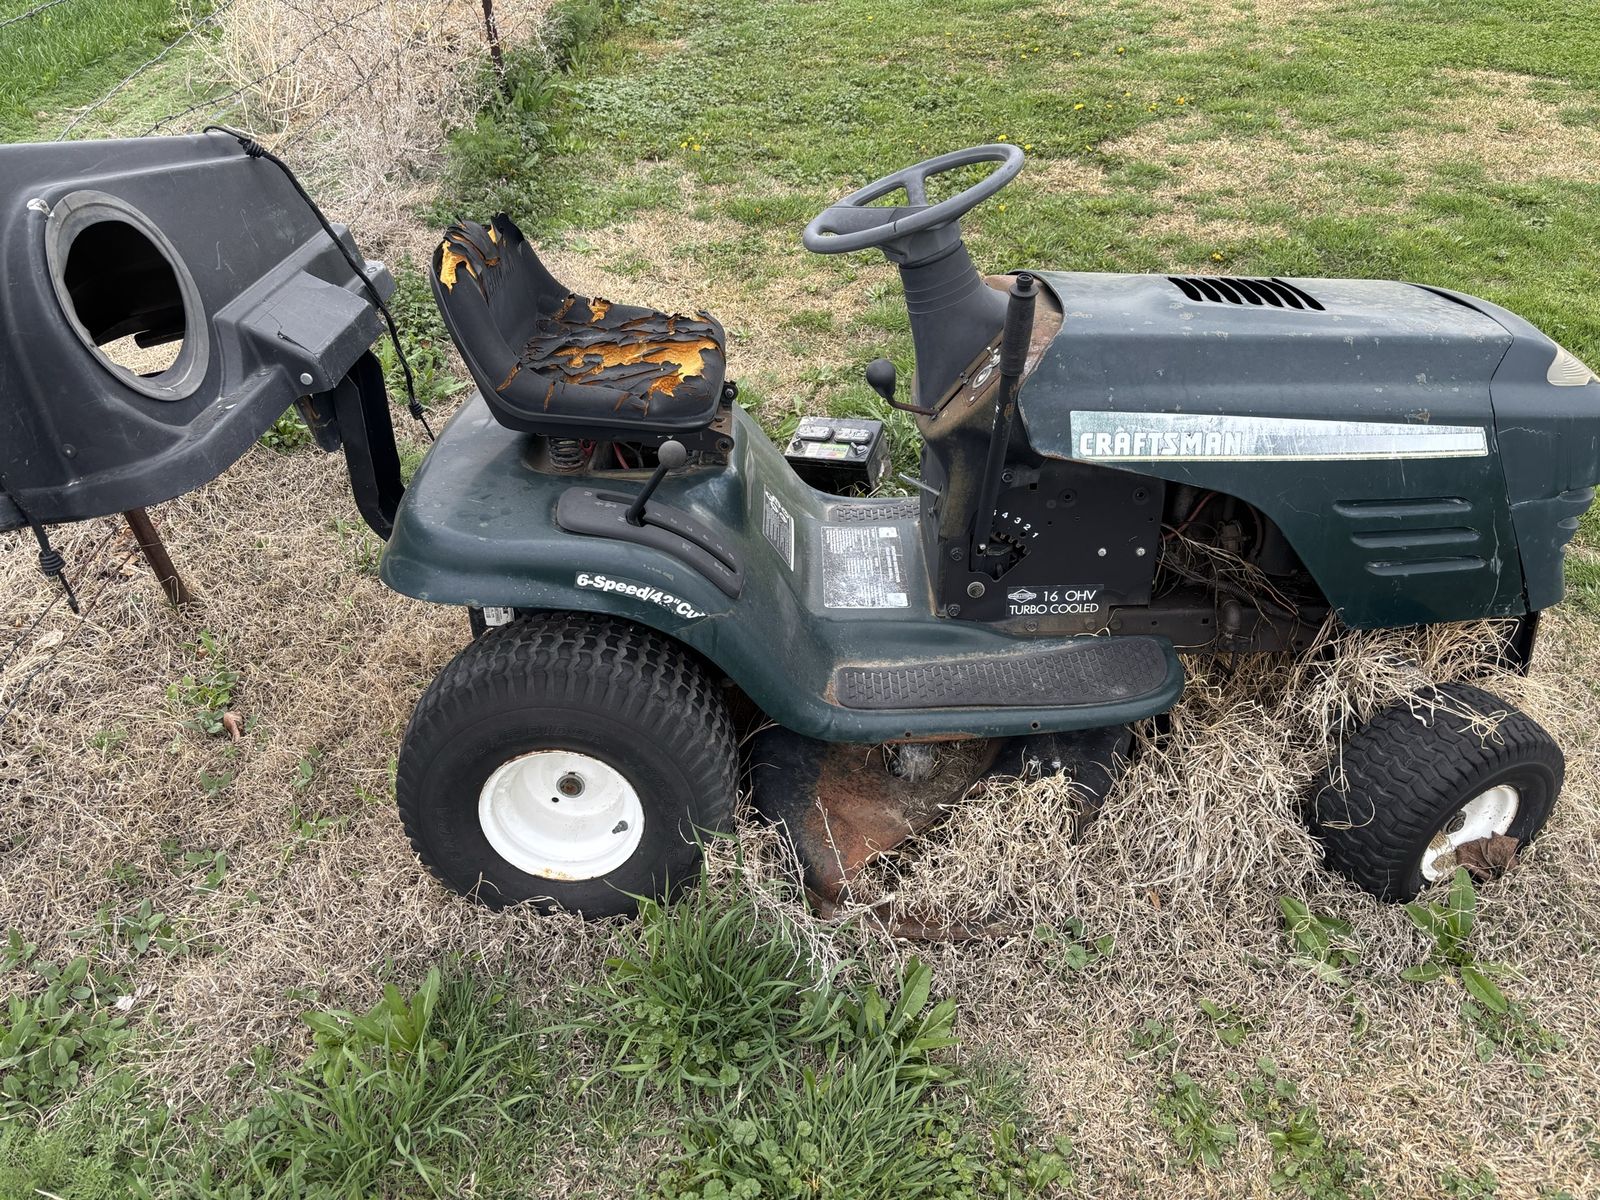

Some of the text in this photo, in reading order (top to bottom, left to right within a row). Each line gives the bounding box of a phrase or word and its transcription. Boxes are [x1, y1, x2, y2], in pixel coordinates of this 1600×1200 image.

[1079, 430, 1244, 457] CRAFTSMAN
[1023, 523, 1032, 531] 2
[1043, 590, 1059, 602] 16
[1065, 590, 1097, 601] OHV
[1009, 603, 1099, 615] TURBO COOLED
